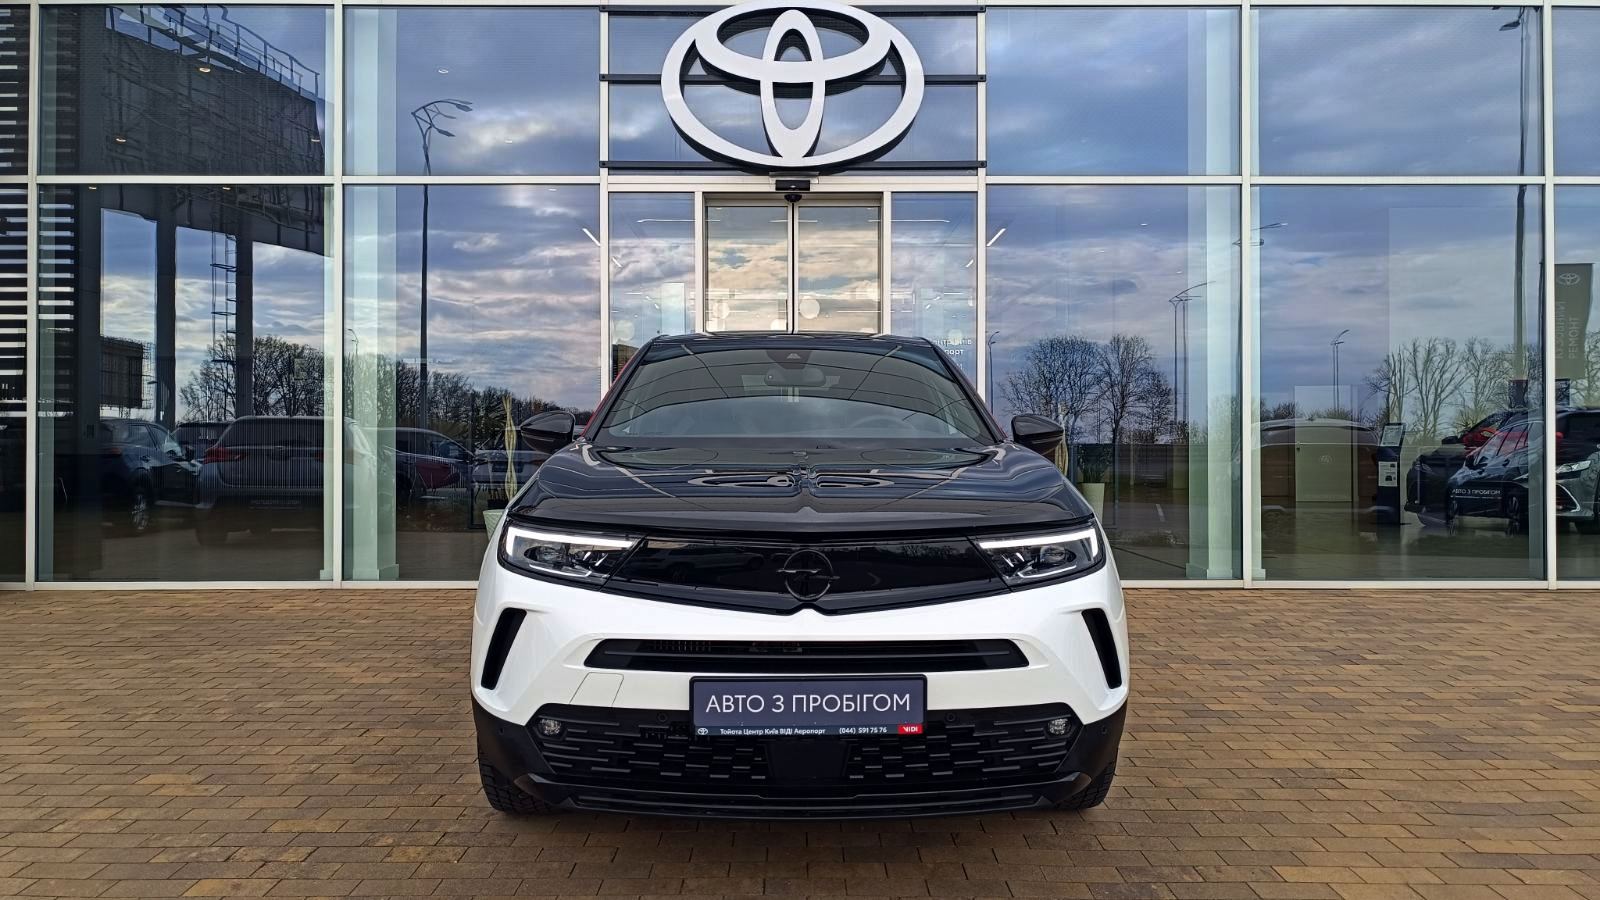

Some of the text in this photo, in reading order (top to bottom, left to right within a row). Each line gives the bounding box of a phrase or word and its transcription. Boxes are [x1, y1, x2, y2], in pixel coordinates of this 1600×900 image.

[1568, 316, 1580, 360] РЕМОНТ
[706, 693, 910, 713] АВТО З ПРОБІГОМ
[743, 728, 763, 736] Центр
[794, 728, 826, 736] Аеропорт
[839, 727, 856, 735] (044)
